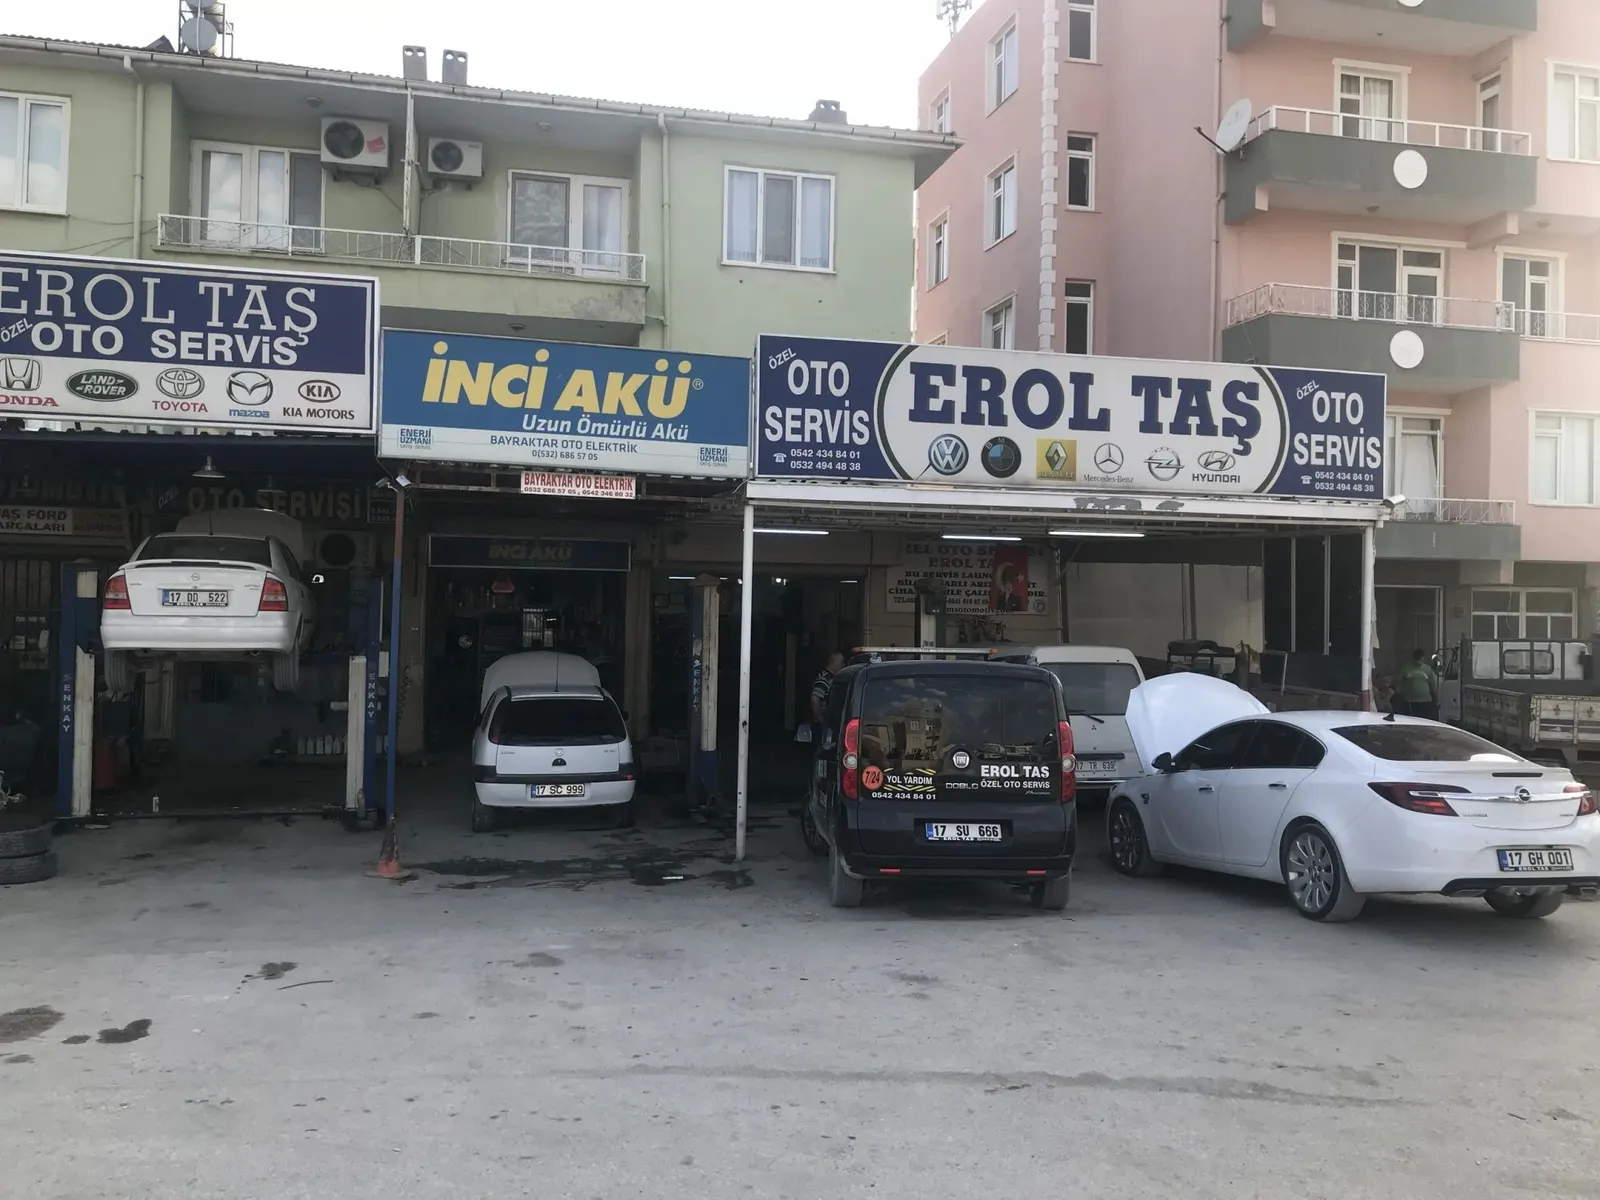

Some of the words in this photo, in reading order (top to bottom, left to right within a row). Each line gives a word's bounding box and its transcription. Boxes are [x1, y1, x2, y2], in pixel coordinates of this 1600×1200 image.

[0, 266, 175, 324] EROL
[198, 281, 318, 346] TAŞ
[0, 318, 33, 342] ÖZEL
[31, 321, 124, 356] OTO
[768, 347, 797, 370] ÖZEL
[422, 340, 549, 410] İNCİ
[553, 358, 692, 419] AKÜ
[787, 359, 850, 397] OTO
[1296, 379, 1320, 400] ÖZEL
[152, 400, 208, 413] TOYOTA
[908, 361, 1111, 432] EROL
[1131, 375, 1262, 456] TAŞ
[1312, 391, 1364, 425] OTO
[229, 409, 270, 418] mazda
[283, 407, 302, 417] KIA
[306, 408, 354, 420] MOTORS
[521, 413, 571, 433] Uzun
[576, 414, 648, 439] Ömürlü
[650, 423, 689, 441] Akü
[764, 400, 870, 446] SERVİS
[490, 435, 558, 449] BAYRAKTAR
[560, 439, 584, 452] OTO
[1293, 428, 1382, 469] SERVİS
[532, 450, 558, 460] 0(532)
[560, 451, 575, 460] 686
[577, 452, 587, 460] 57
[588, 452, 598, 461] 05
[790, 448, 814, 458] 0542
[816, 449, 833, 459] 434
[835, 450, 847, 460] 84
[849, 451, 860, 460] 01
[790, 460, 814, 469] 0532
[815, 461, 833, 471] 494
[835, 462, 847, 471] 48
[849, 462, 861, 472] 38
[524, 472, 573, 488] BAYRAKTAR
[575, 476, 592, 489] OTO
[1083, 474, 1134, 483] Mercedes-Benz
[1191, 473, 1241, 483] HYUNDAI
[1315, 471, 1334, 480] 0542
[1336, 472, 1351, 480] 434
[1352, 473, 1363, 481] 84
[1364, 474, 1374, 482] 01
[1315, 482, 1334, 491] 0532
[1336, 483, 1351, 491] 494
[1352, 484, 1363, 492] 48
[1364, 484, 1375, 492] 38
[27, 509, 67, 521] FORD
[929, 557, 974, 568] EROL
[171, 592, 181, 602] 17
[208, 592, 226, 603] 522
[981, 765, 1019, 778] EROL
[1089, 761, 1097, 770] TR
[865, 771, 880, 786] 7/24
[887, 775, 902, 784] YOL
[903, 776, 933, 786] YARDIM
[980, 778, 1002, 789] ÖZEL
[1003, 780, 1021, 789] OTO
[536, 786, 545, 795] 17
[549, 786, 563, 795] SC
[566, 785, 583, 795] 999
[945, 782, 979, 790] DOBLO
[934, 824, 946, 836] 17
[956, 824, 970, 837] SU
[978, 825, 999, 838] 666
[1508, 852, 1522, 866] 17
[1528, 851, 1544, 866] GH
[1548, 851, 1569, 865] 001
